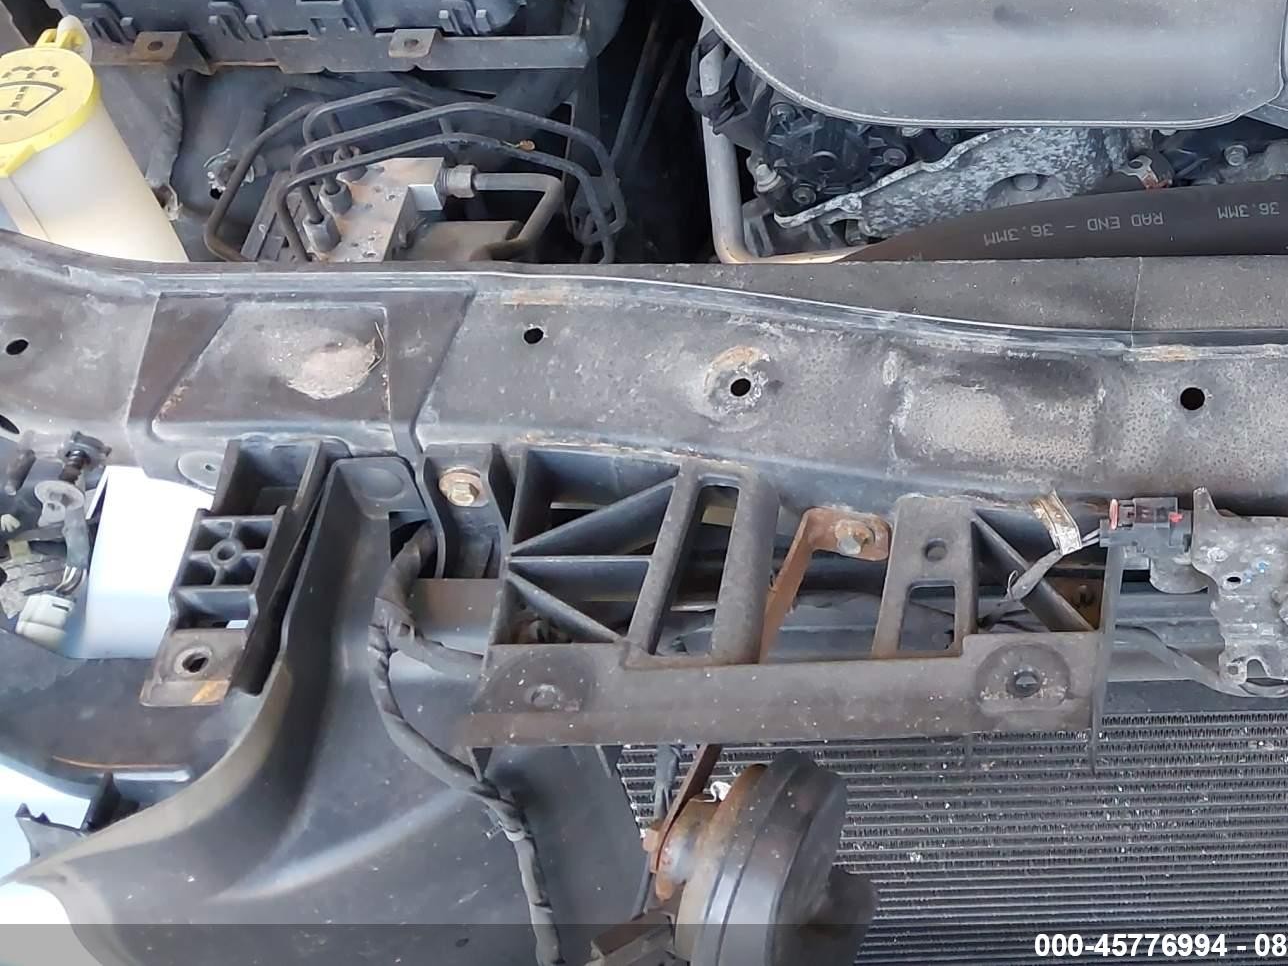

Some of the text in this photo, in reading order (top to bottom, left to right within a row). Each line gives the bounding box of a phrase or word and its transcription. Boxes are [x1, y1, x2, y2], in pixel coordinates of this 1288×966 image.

[1217, 201, 1280, 219] 36.3MM
[1087, 215, 1120, 232] END
[1131, 211, 1164, 227] RAD
[983, 223, 1054, 247] 36.3MM
